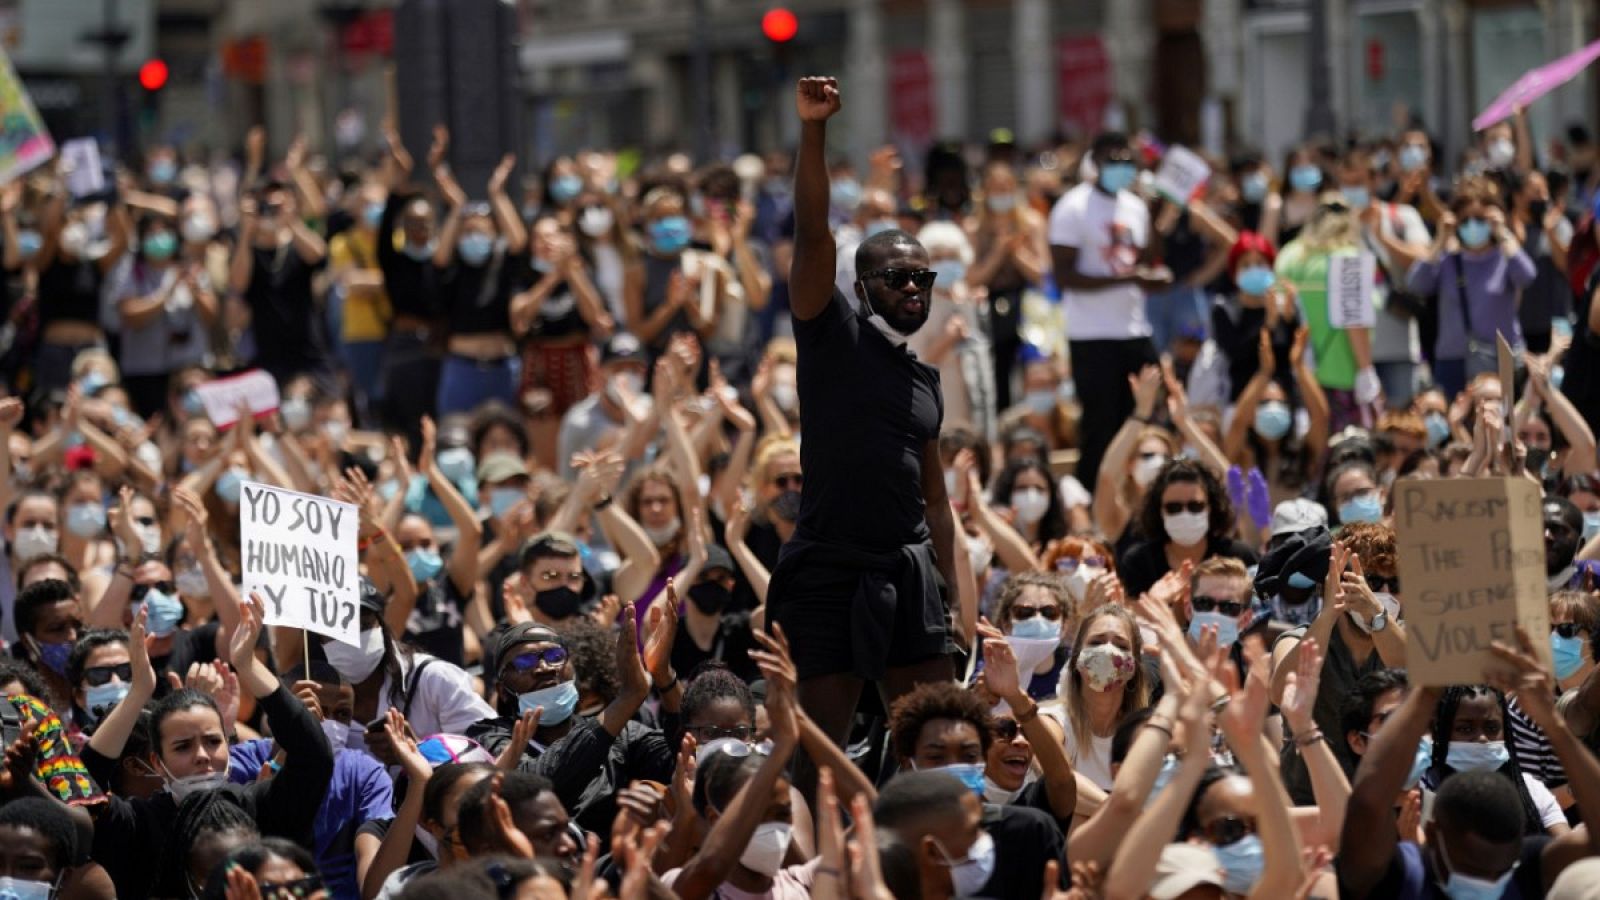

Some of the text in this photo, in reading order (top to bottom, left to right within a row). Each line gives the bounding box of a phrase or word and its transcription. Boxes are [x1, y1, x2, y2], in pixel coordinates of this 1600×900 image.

[244, 486, 343, 540] YO SOY
[1408, 543, 1464, 573] THE
